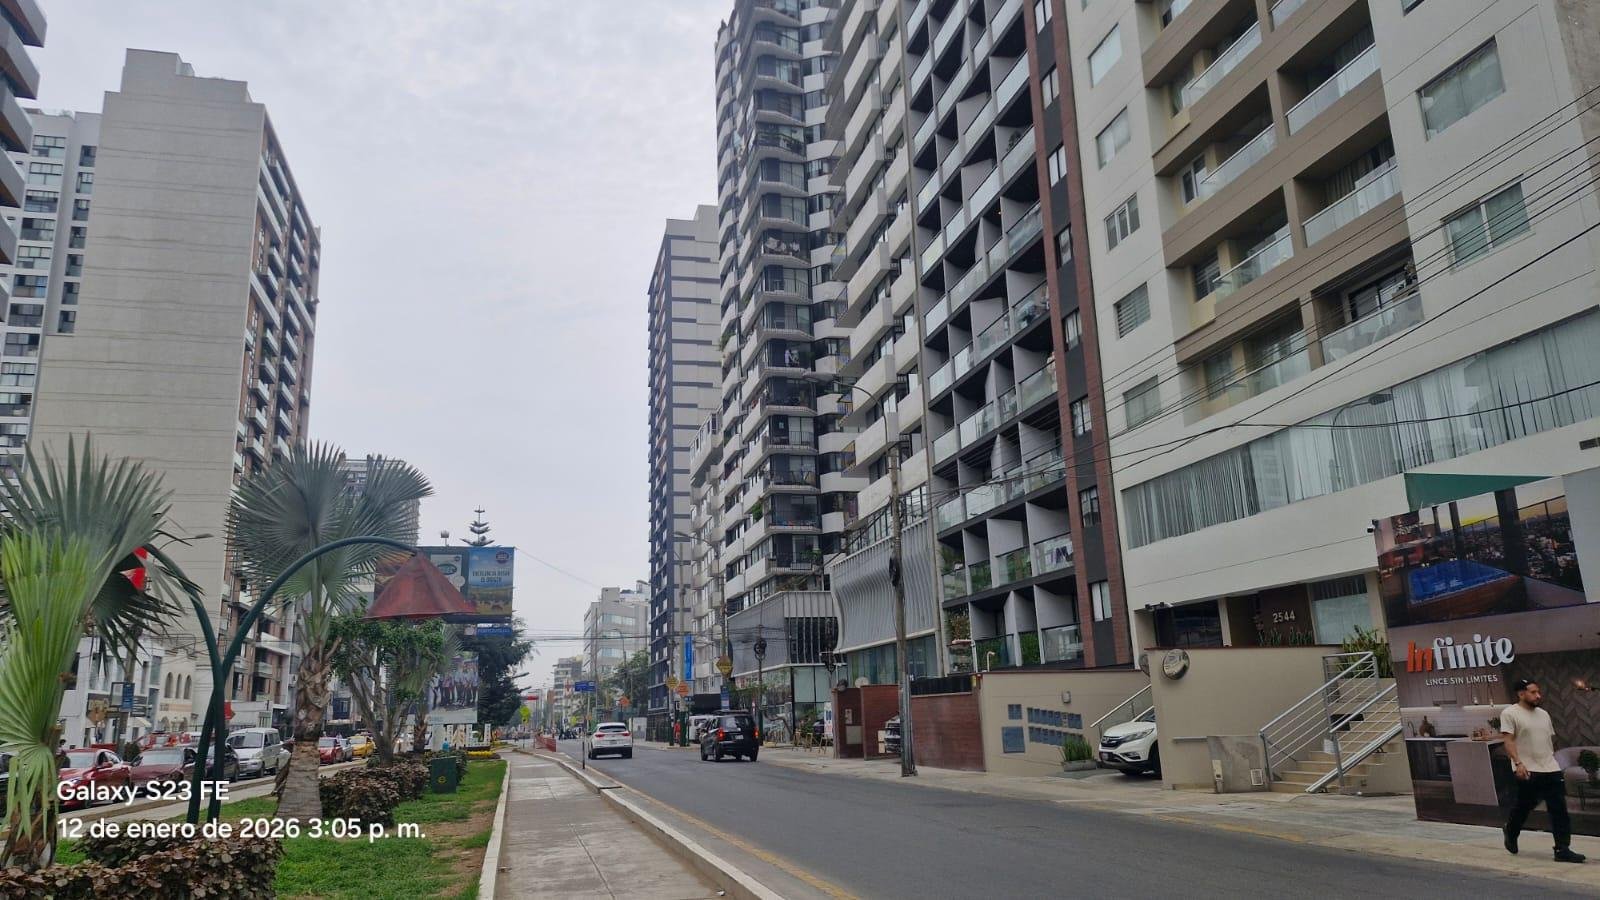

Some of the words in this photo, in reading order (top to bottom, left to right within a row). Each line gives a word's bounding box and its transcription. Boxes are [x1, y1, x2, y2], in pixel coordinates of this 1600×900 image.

[1272, 610, 1296, 623] 2544
[1406, 633, 1515, 673] Infinite
[1425, 678, 1449, 686] LINCE
[1450, 676, 1464, 684] SIN
